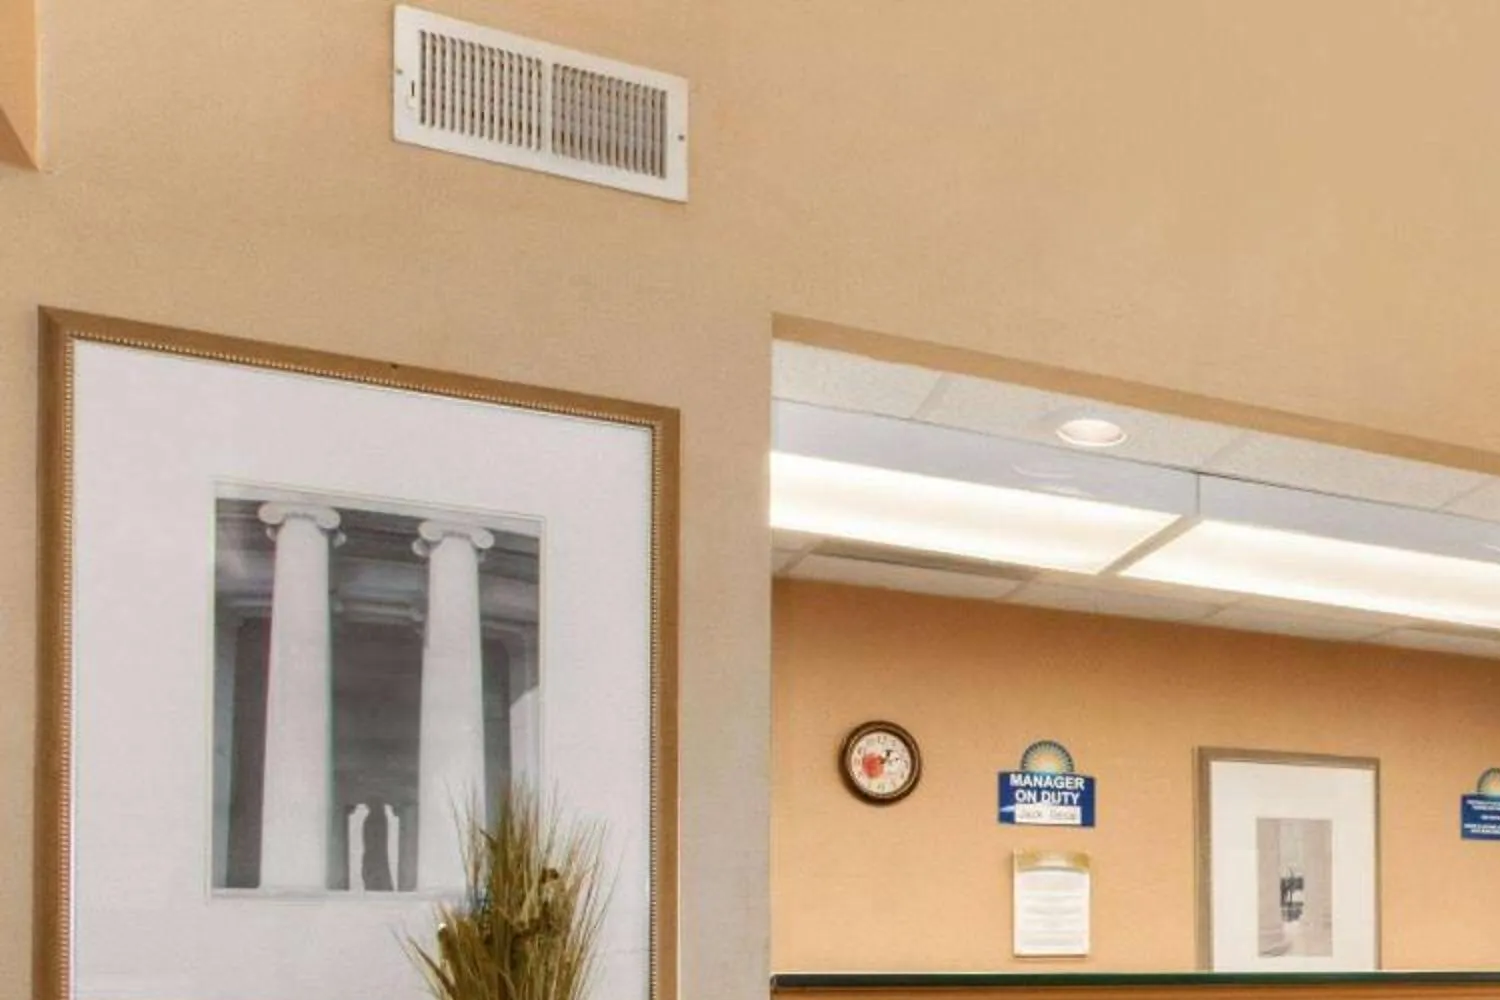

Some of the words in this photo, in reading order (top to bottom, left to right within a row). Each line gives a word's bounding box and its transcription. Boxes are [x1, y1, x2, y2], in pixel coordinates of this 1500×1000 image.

[1009, 774, 1085, 791] MANAGER
[1015, 789, 1037, 803] ON
[1041, 791, 1080, 805] DUTY
